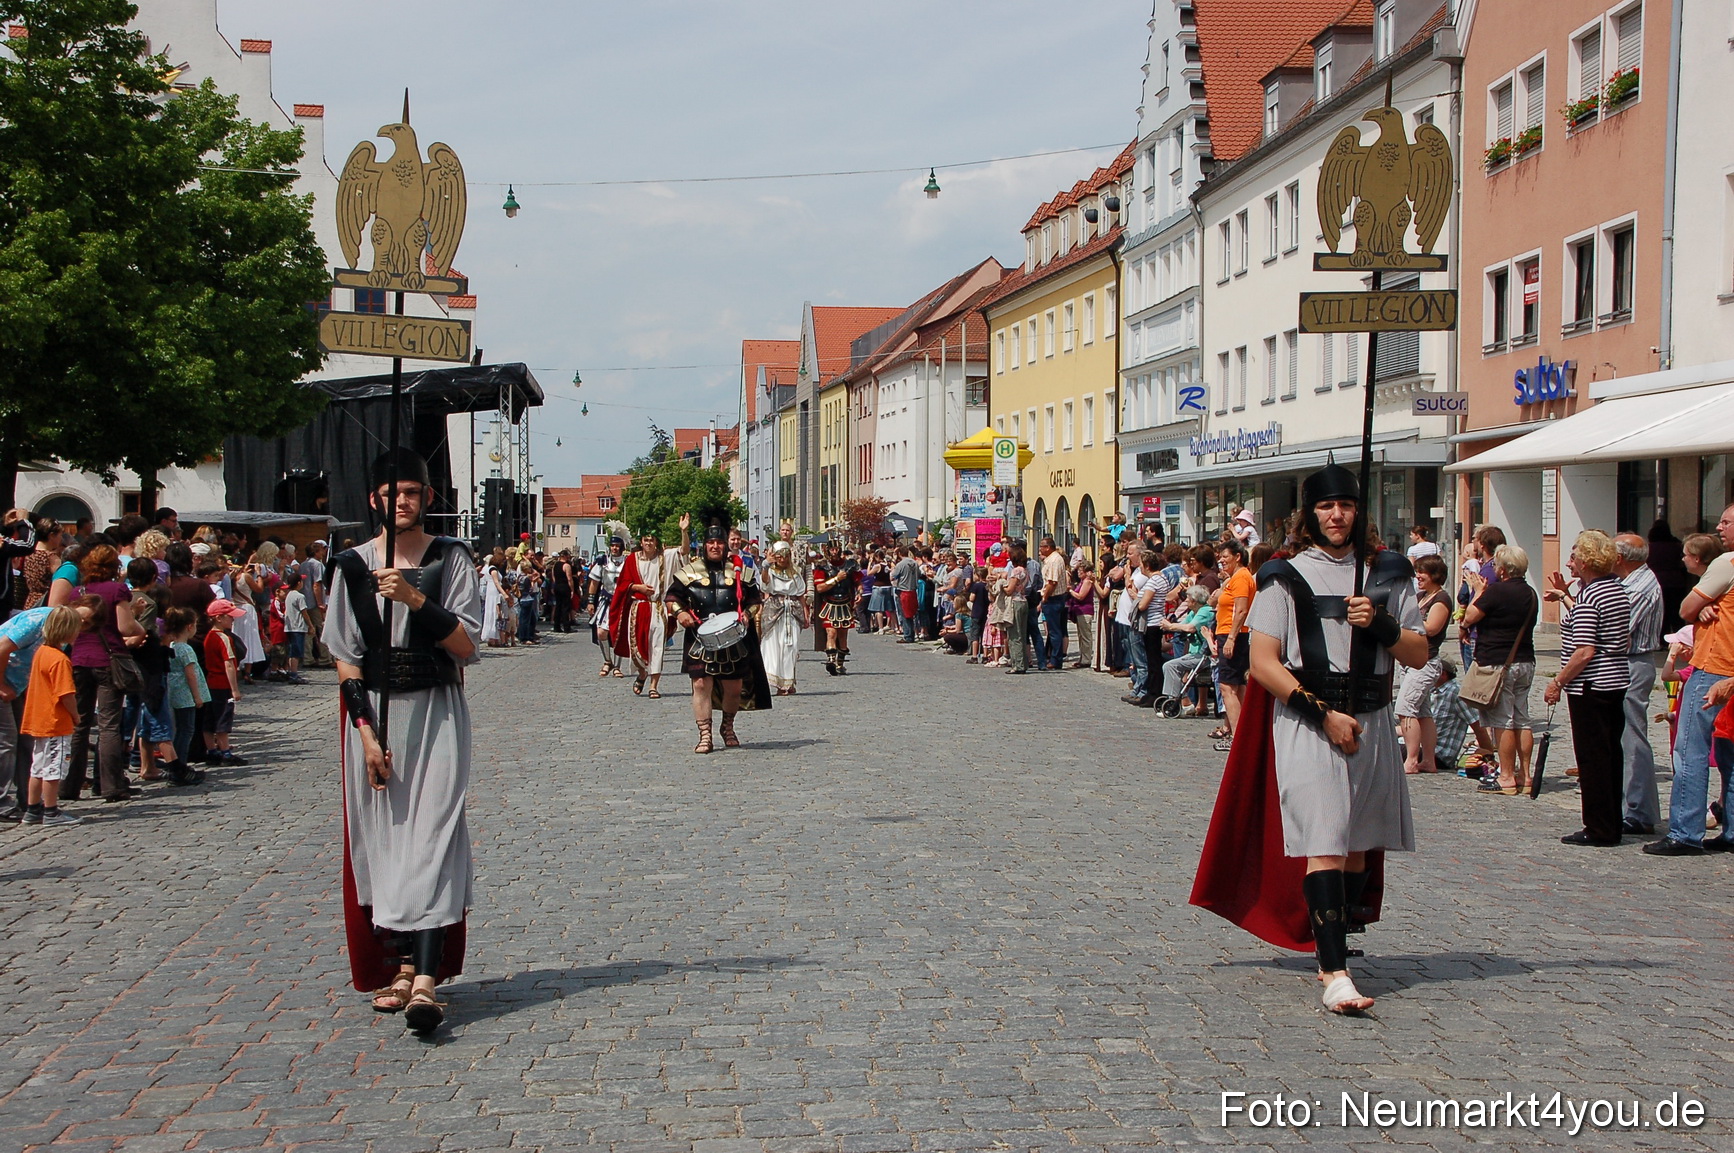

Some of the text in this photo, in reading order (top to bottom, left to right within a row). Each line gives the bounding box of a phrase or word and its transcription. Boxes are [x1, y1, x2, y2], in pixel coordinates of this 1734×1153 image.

[1416, 395, 1467, 411] sutor.
[1189, 424, 1278, 456] Buchhandlung Rupprecht
[1064, 468, 1076, 487] DELI
[1471, 691, 1487, 702] NYC
